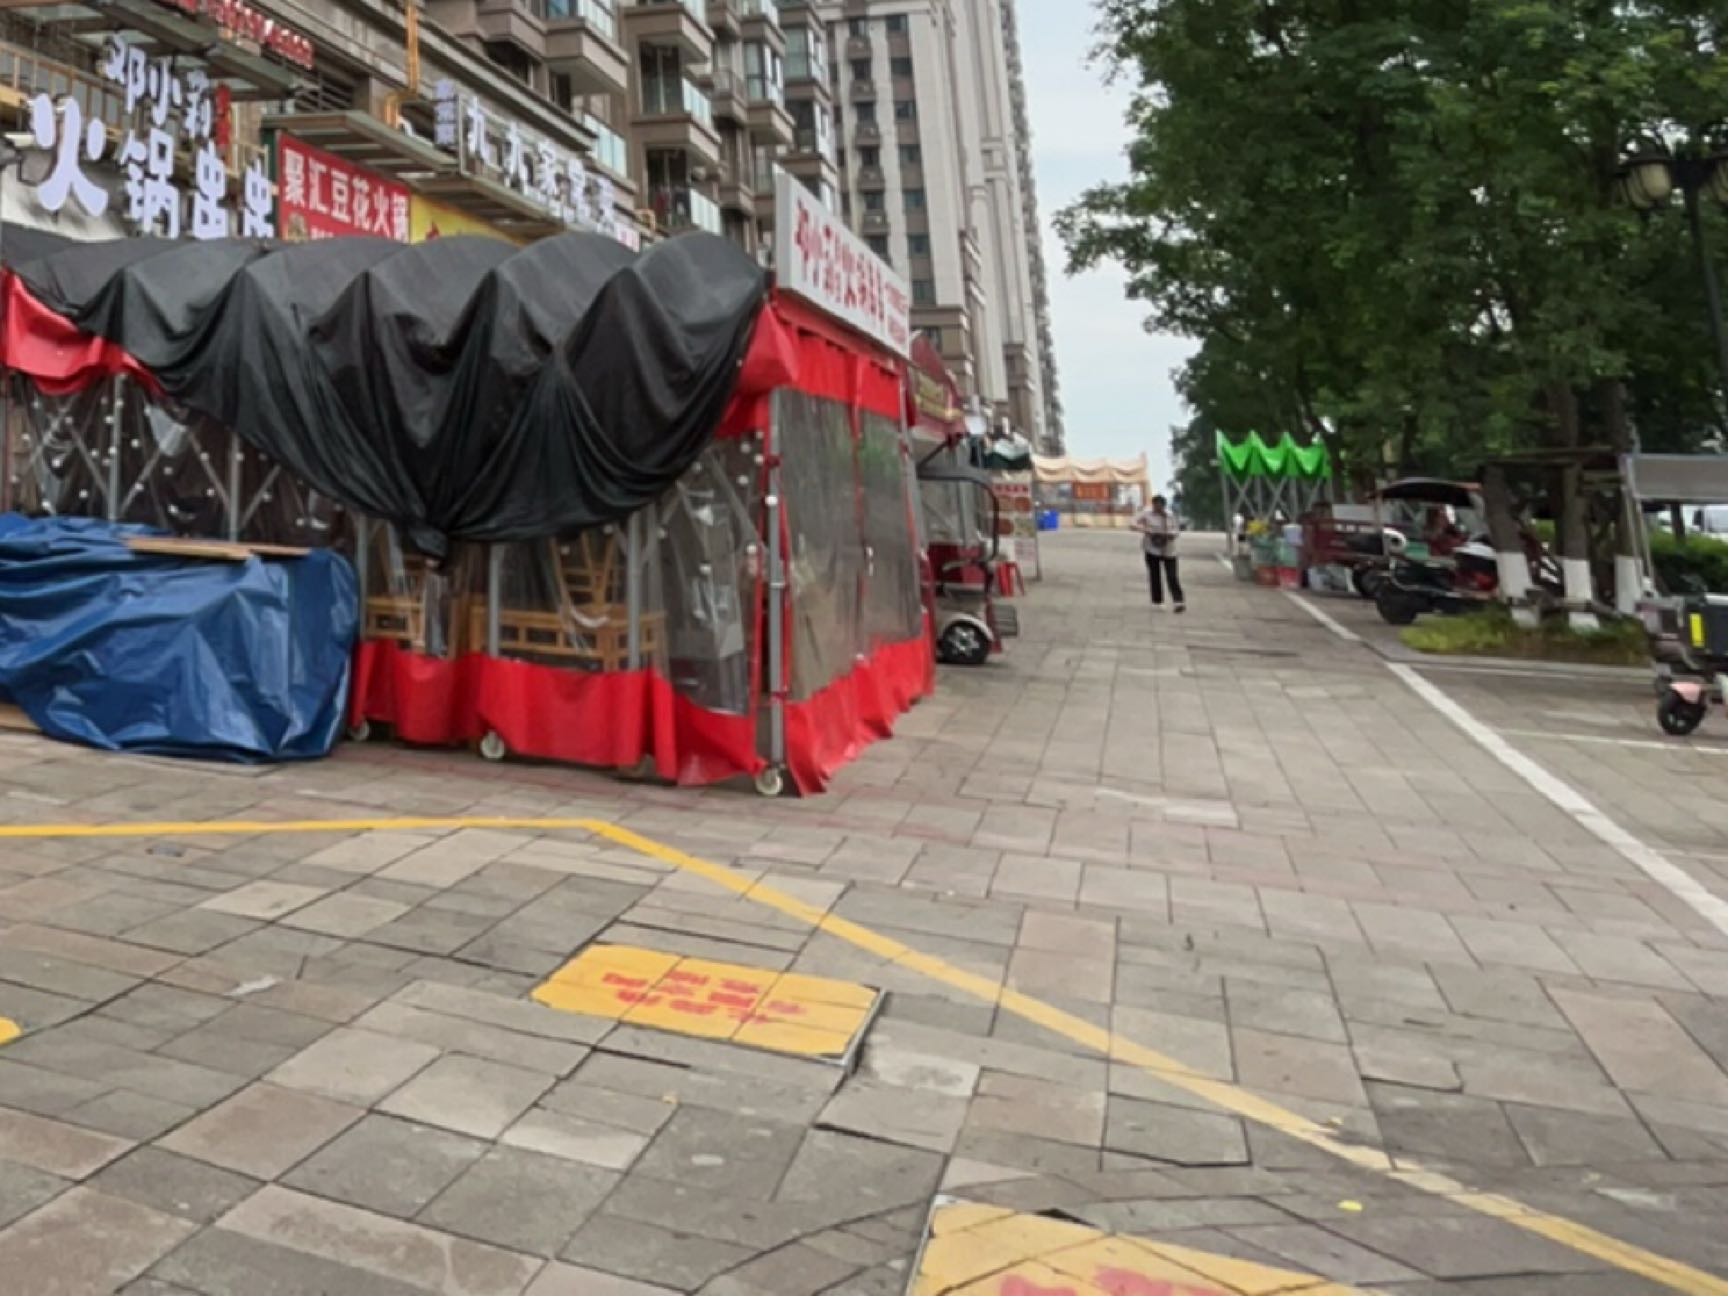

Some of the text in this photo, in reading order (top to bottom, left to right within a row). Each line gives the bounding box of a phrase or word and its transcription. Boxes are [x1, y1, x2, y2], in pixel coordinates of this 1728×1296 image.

[104, 34, 212, 139] 邓小莉
[33, 92, 274, 240] 火锅串串
[283, 147, 410, 245] 聚汇豆花火锅
